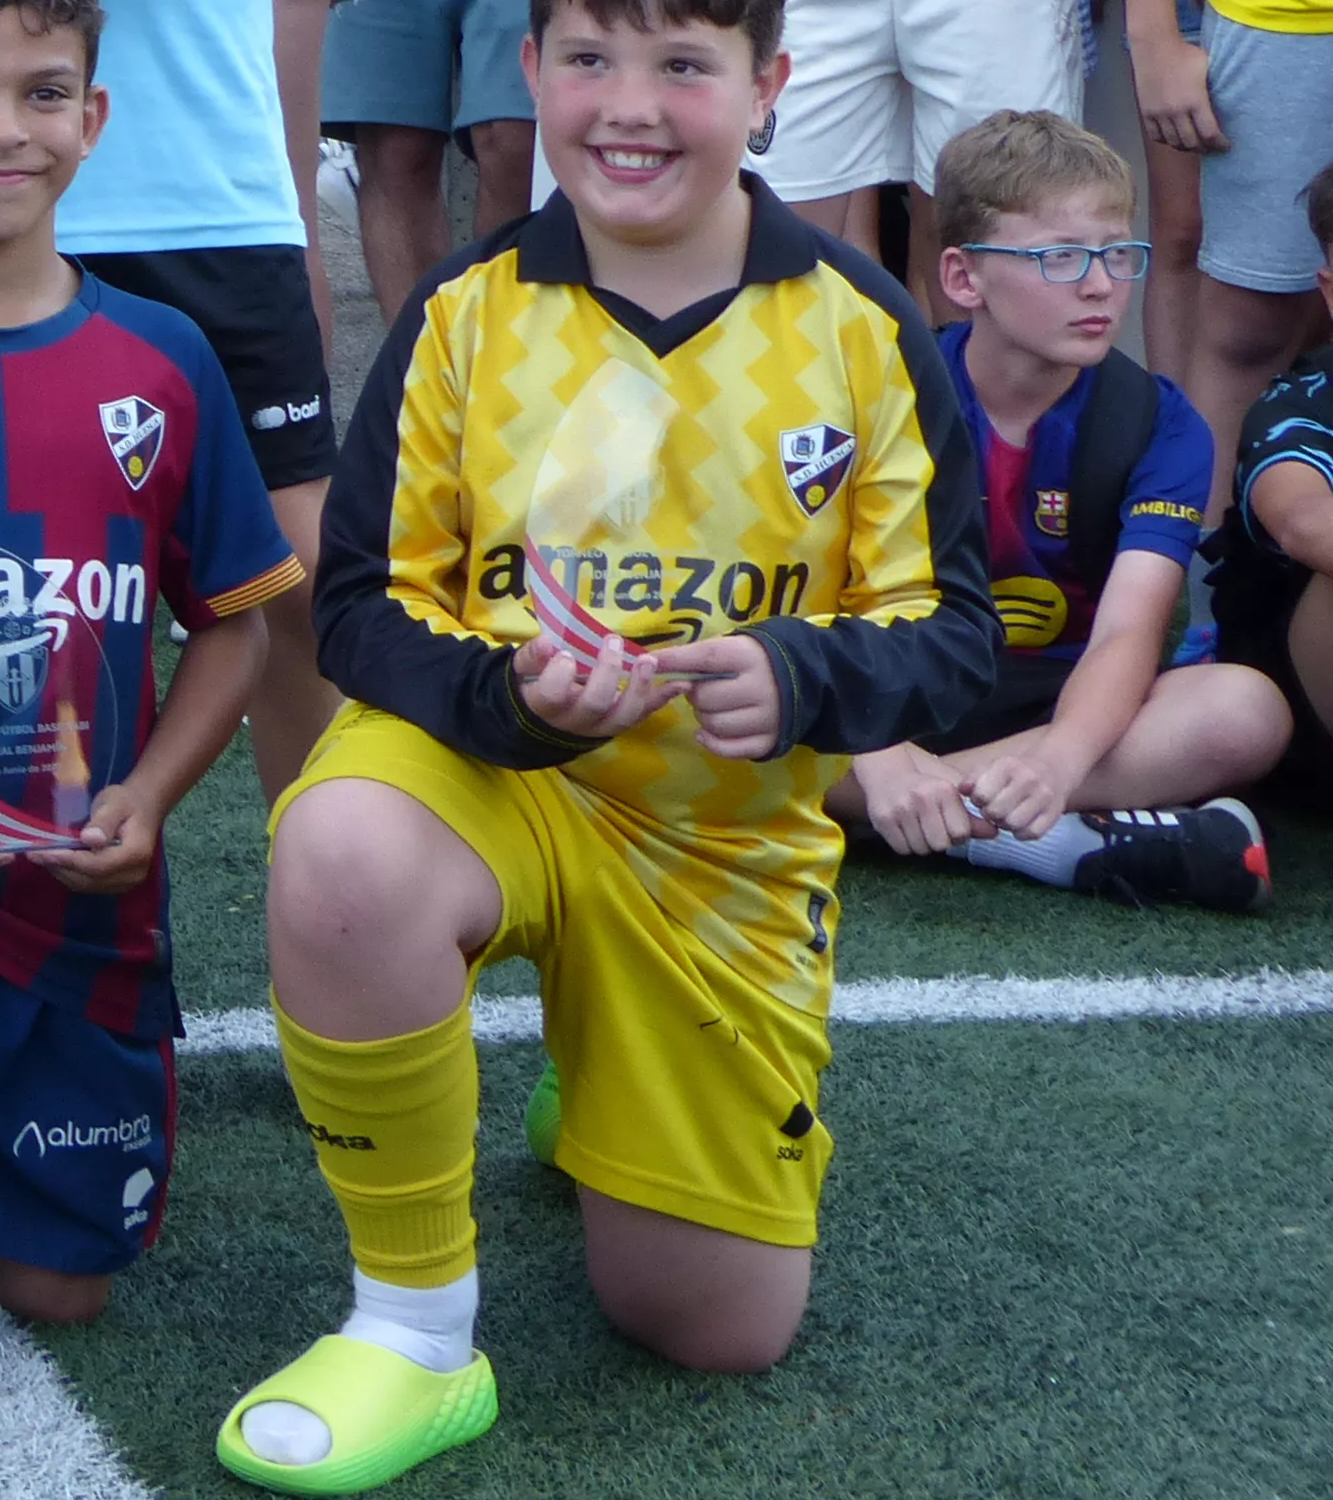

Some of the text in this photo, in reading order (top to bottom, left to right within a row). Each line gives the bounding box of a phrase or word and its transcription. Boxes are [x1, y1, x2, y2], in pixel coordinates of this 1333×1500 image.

[815, 442, 853, 472] HUESCA
[1129, 500, 1202, 525] AMBILIG
[478, 542, 809, 623] amazon
[47, 1114, 151, 1147] alumbra
